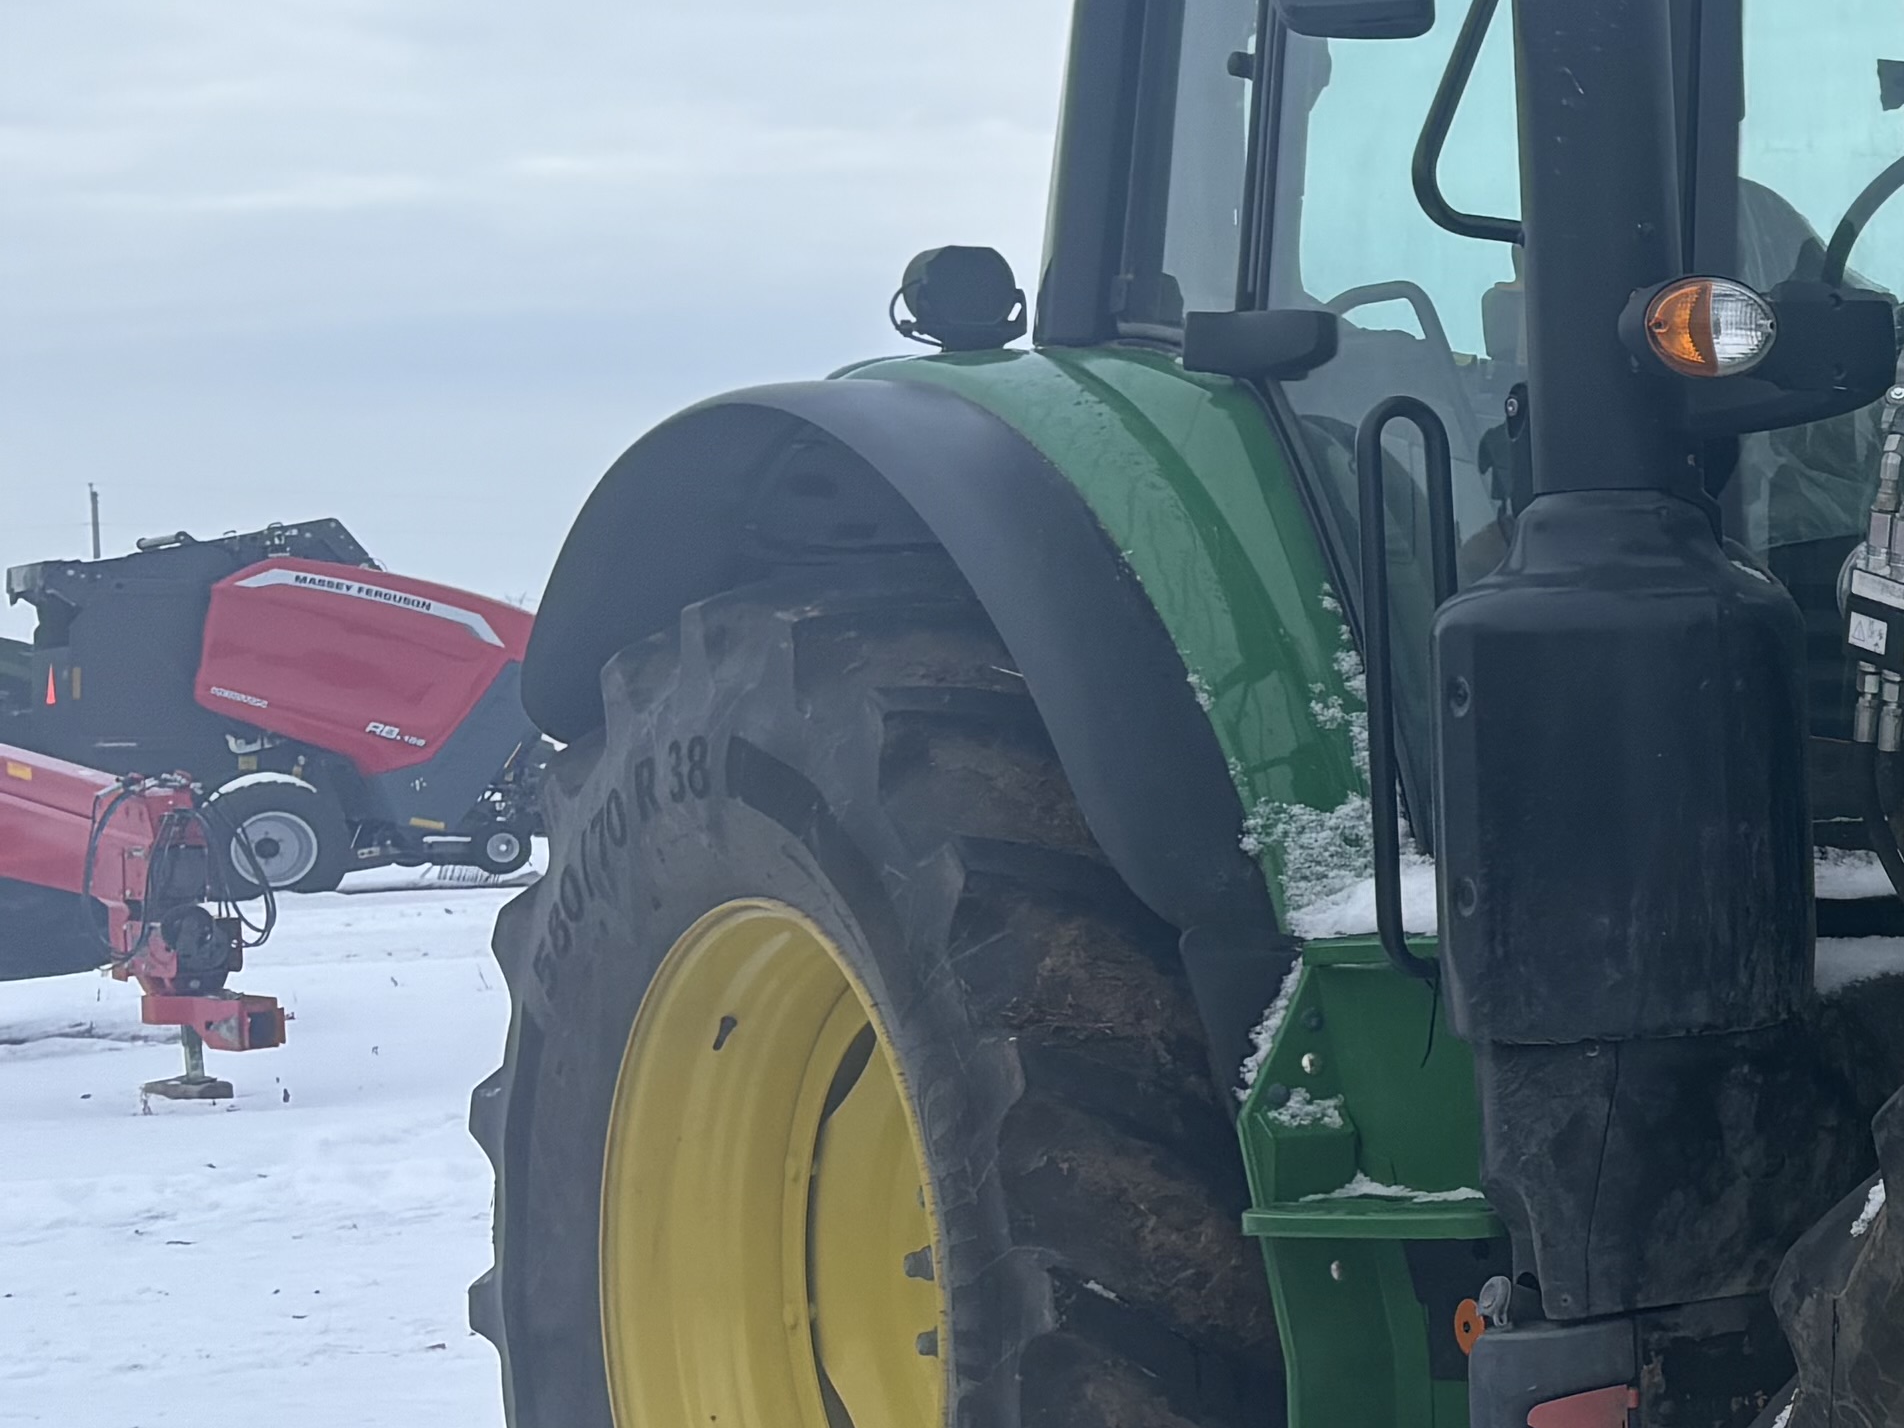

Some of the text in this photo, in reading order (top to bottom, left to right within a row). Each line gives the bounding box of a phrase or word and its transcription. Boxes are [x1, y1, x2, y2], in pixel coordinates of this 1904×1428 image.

[294, 574, 432, 611] MASSEY FERGUSON
[532, 734, 711, 1005] 580/70 R 38
